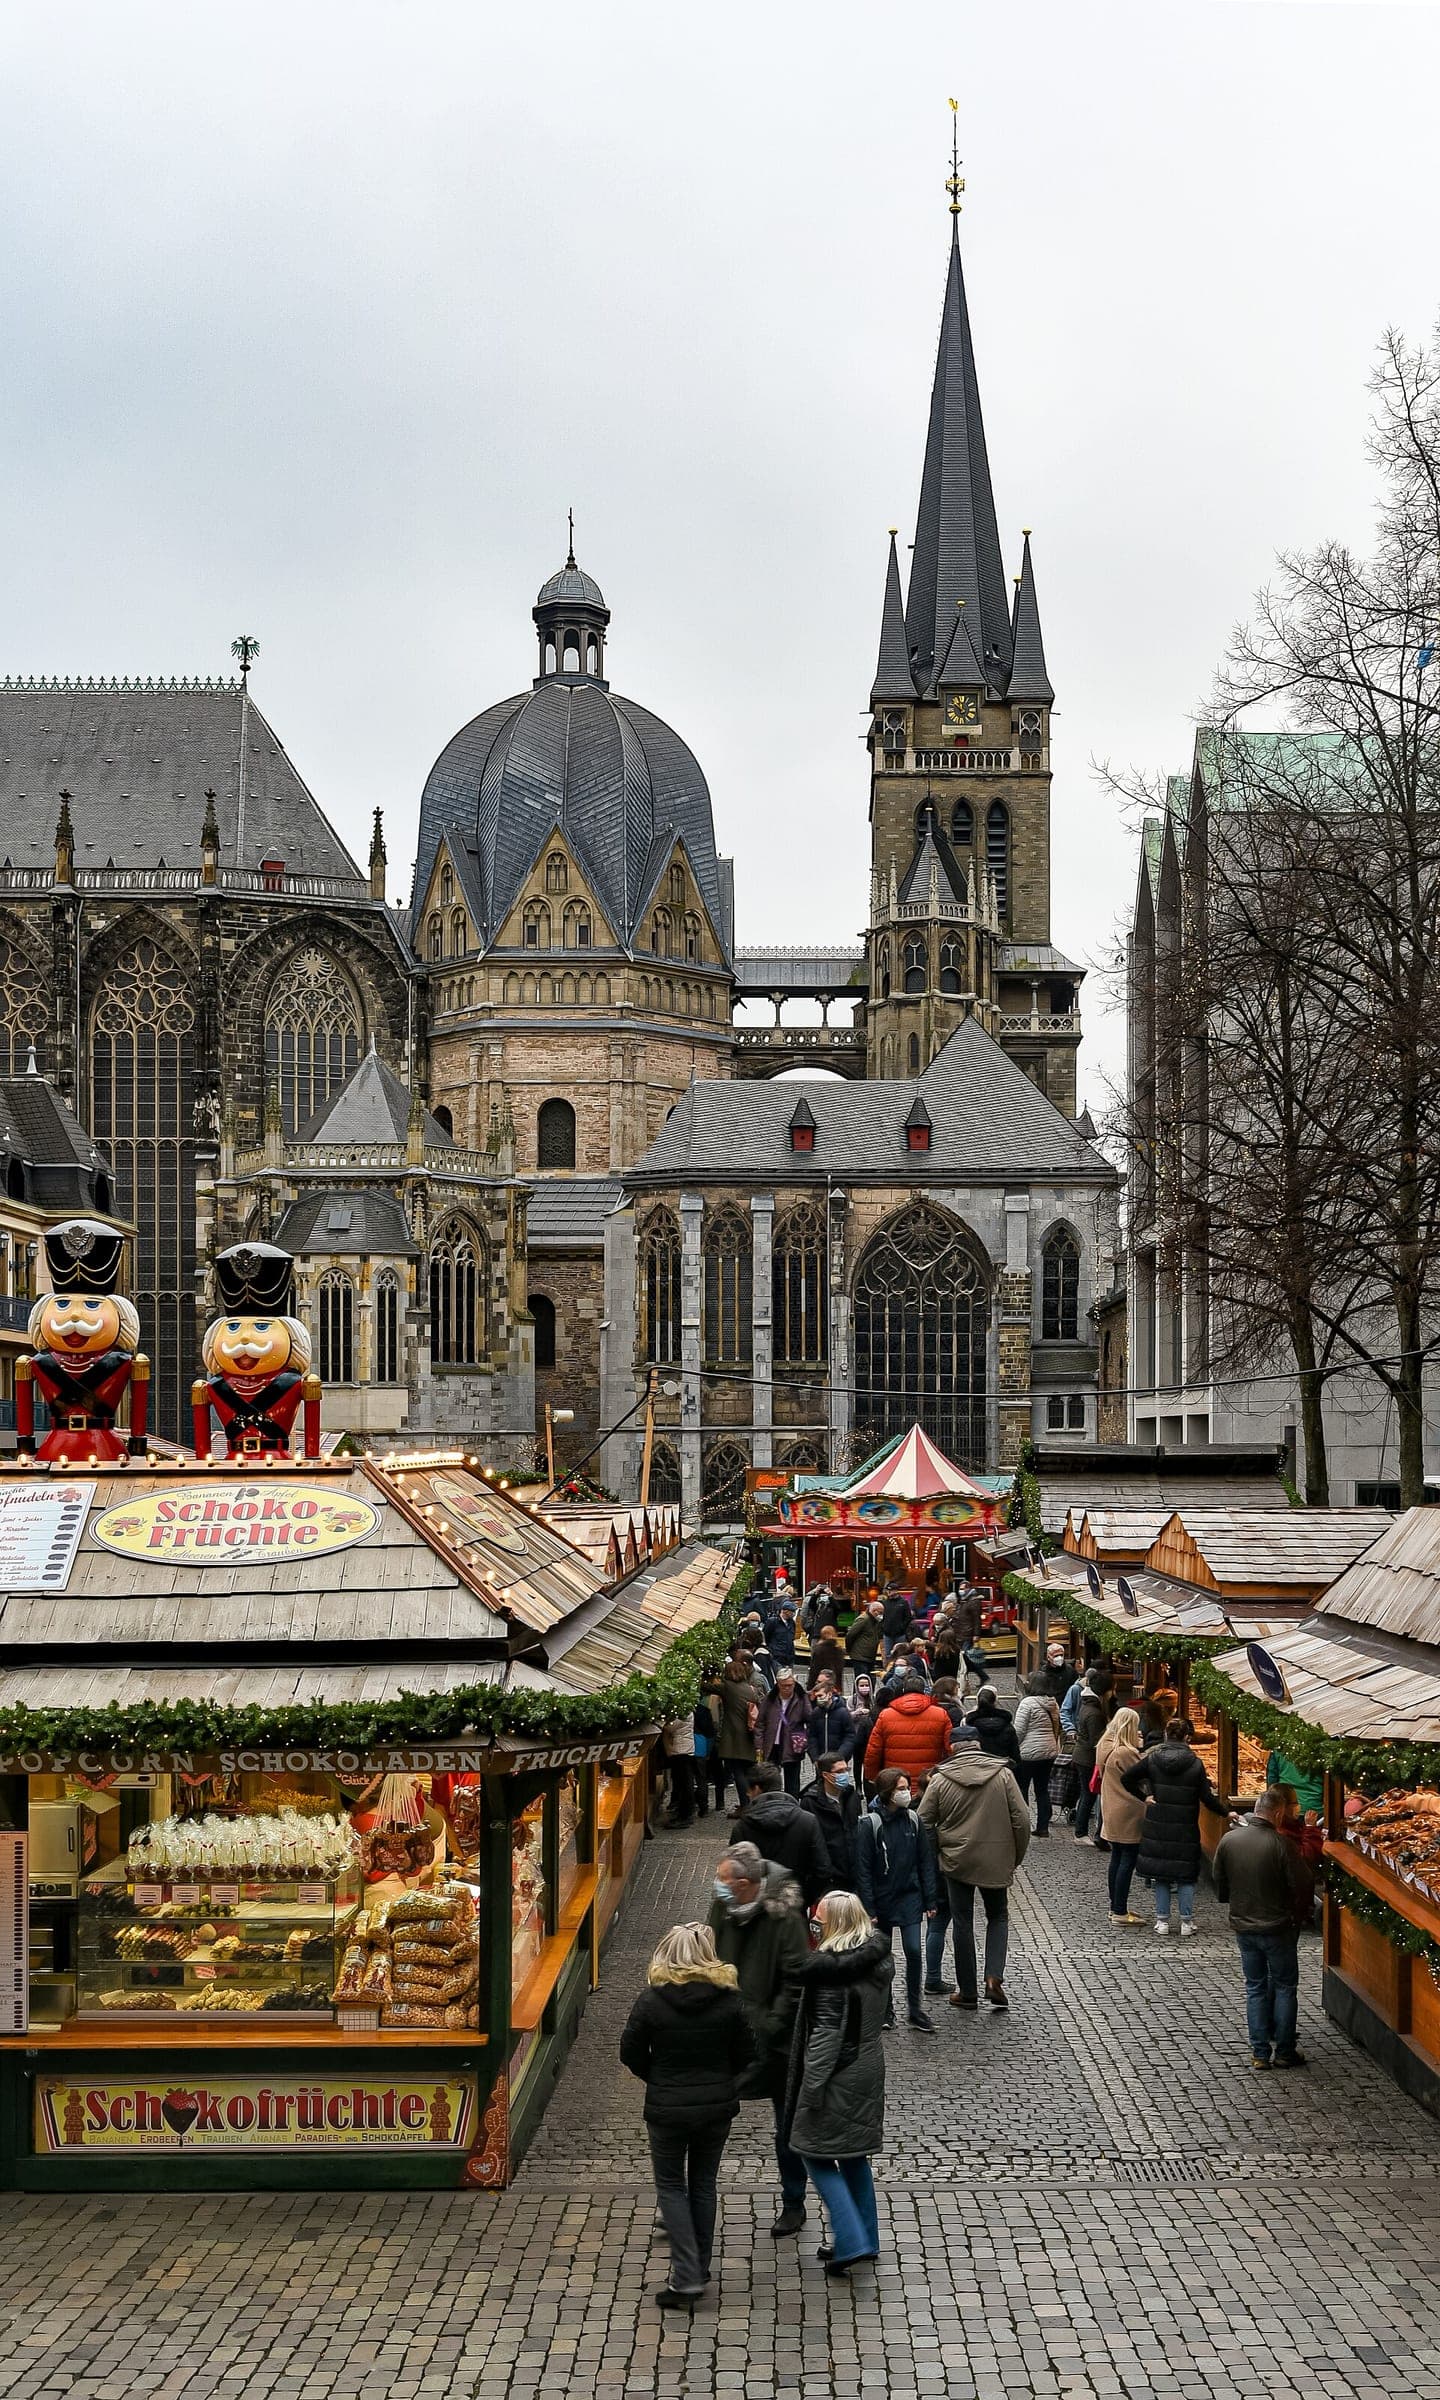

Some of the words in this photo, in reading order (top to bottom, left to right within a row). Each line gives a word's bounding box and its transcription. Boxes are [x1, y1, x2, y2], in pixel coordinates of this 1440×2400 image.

[155, 1498, 334, 1523] Schoko-
[146, 1522, 319, 1548] Früchte
[162, 1548, 217, 1560] Erdbeeren
[256, 1546, 304, 1558] Trauben
[219, 1751, 482, 1772] SCHOKOLADEN
[86, 2087, 426, 2132] Schkofrüchte
